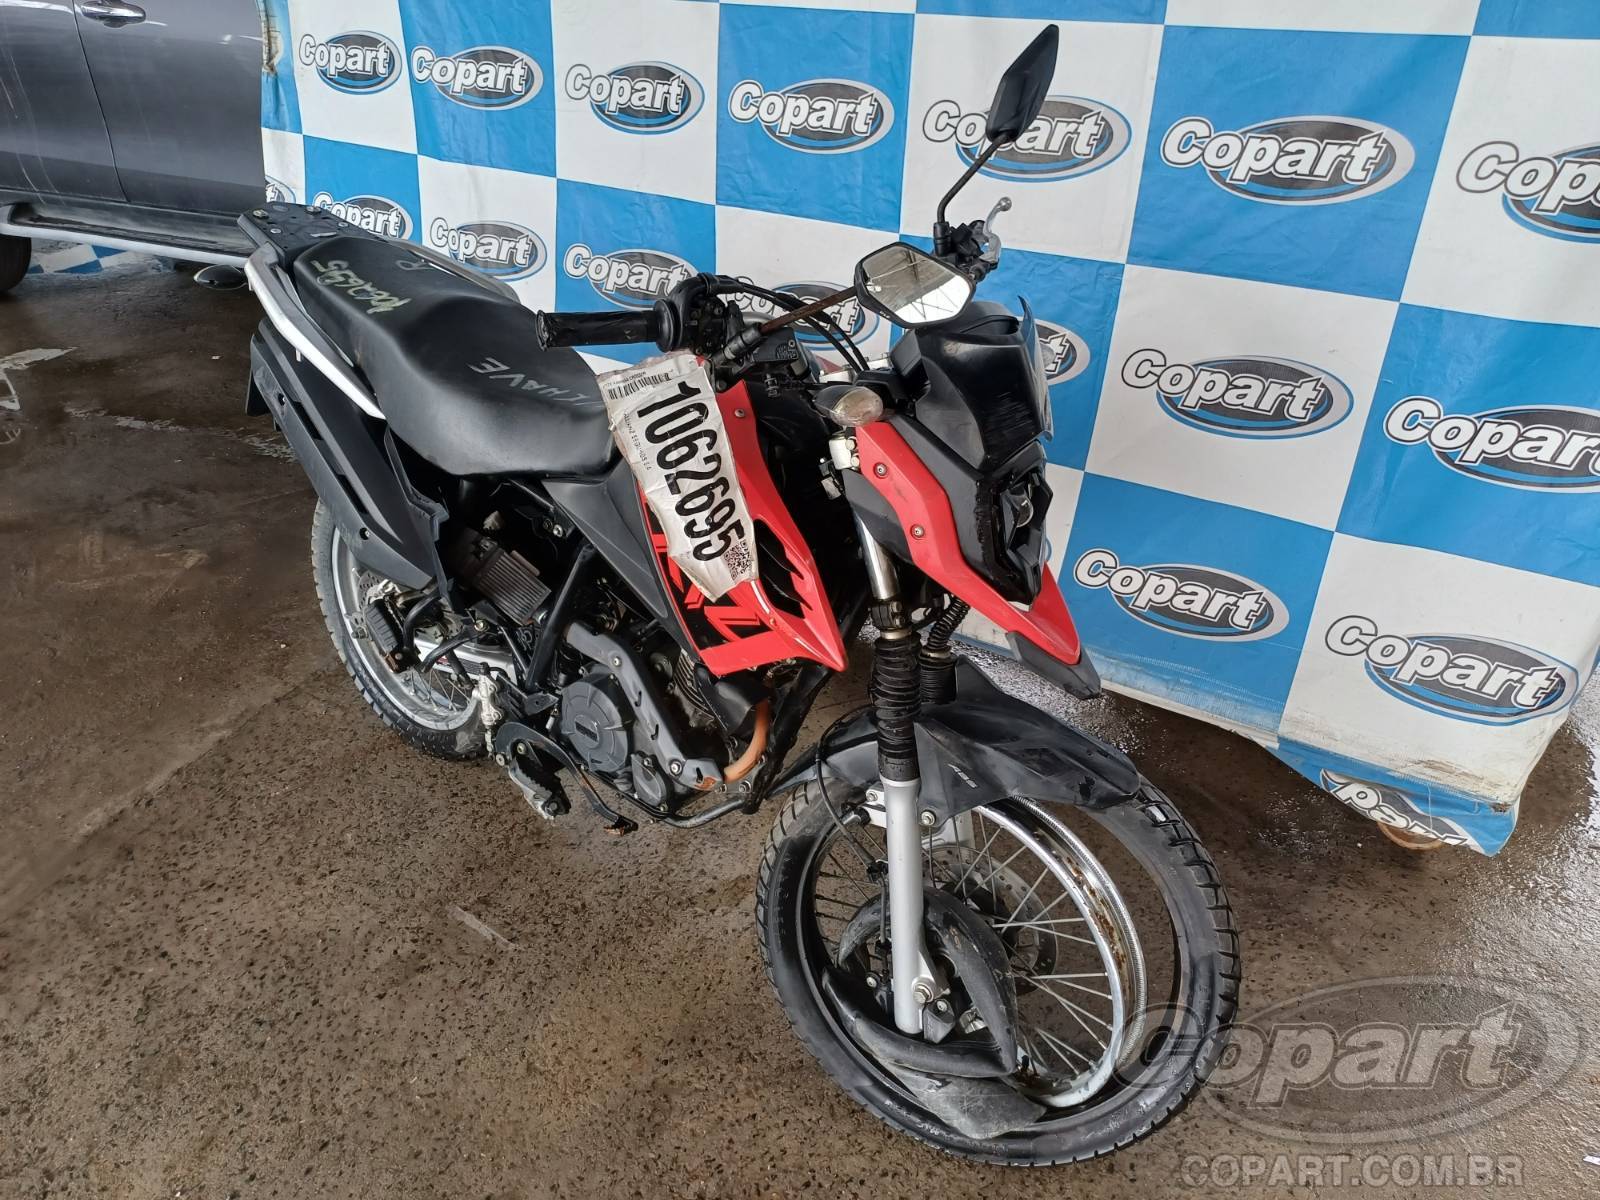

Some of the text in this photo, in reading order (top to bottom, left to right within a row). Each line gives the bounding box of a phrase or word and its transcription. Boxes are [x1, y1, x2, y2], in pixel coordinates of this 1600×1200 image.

[300, 34, 391, 77] Copart
[411, 46, 530, 95] Copart
[565, 63, 686, 115] Copart
[728, 80, 878, 136] Copart
[922, 99, 1104, 159] Coart
[1160, 115, 1387, 185] Copart
[1456, 141, 1600, 215] Cop
[430, 217, 534, 267] Copart
[1121, 348, 1326, 421] Copart
[1383, 396, 1600, 475] Copar
[637, 380, 745, 562] 1062695
[1074, 548, 1267, 631] Copart
[1325, 615, 1561, 709] Copart
